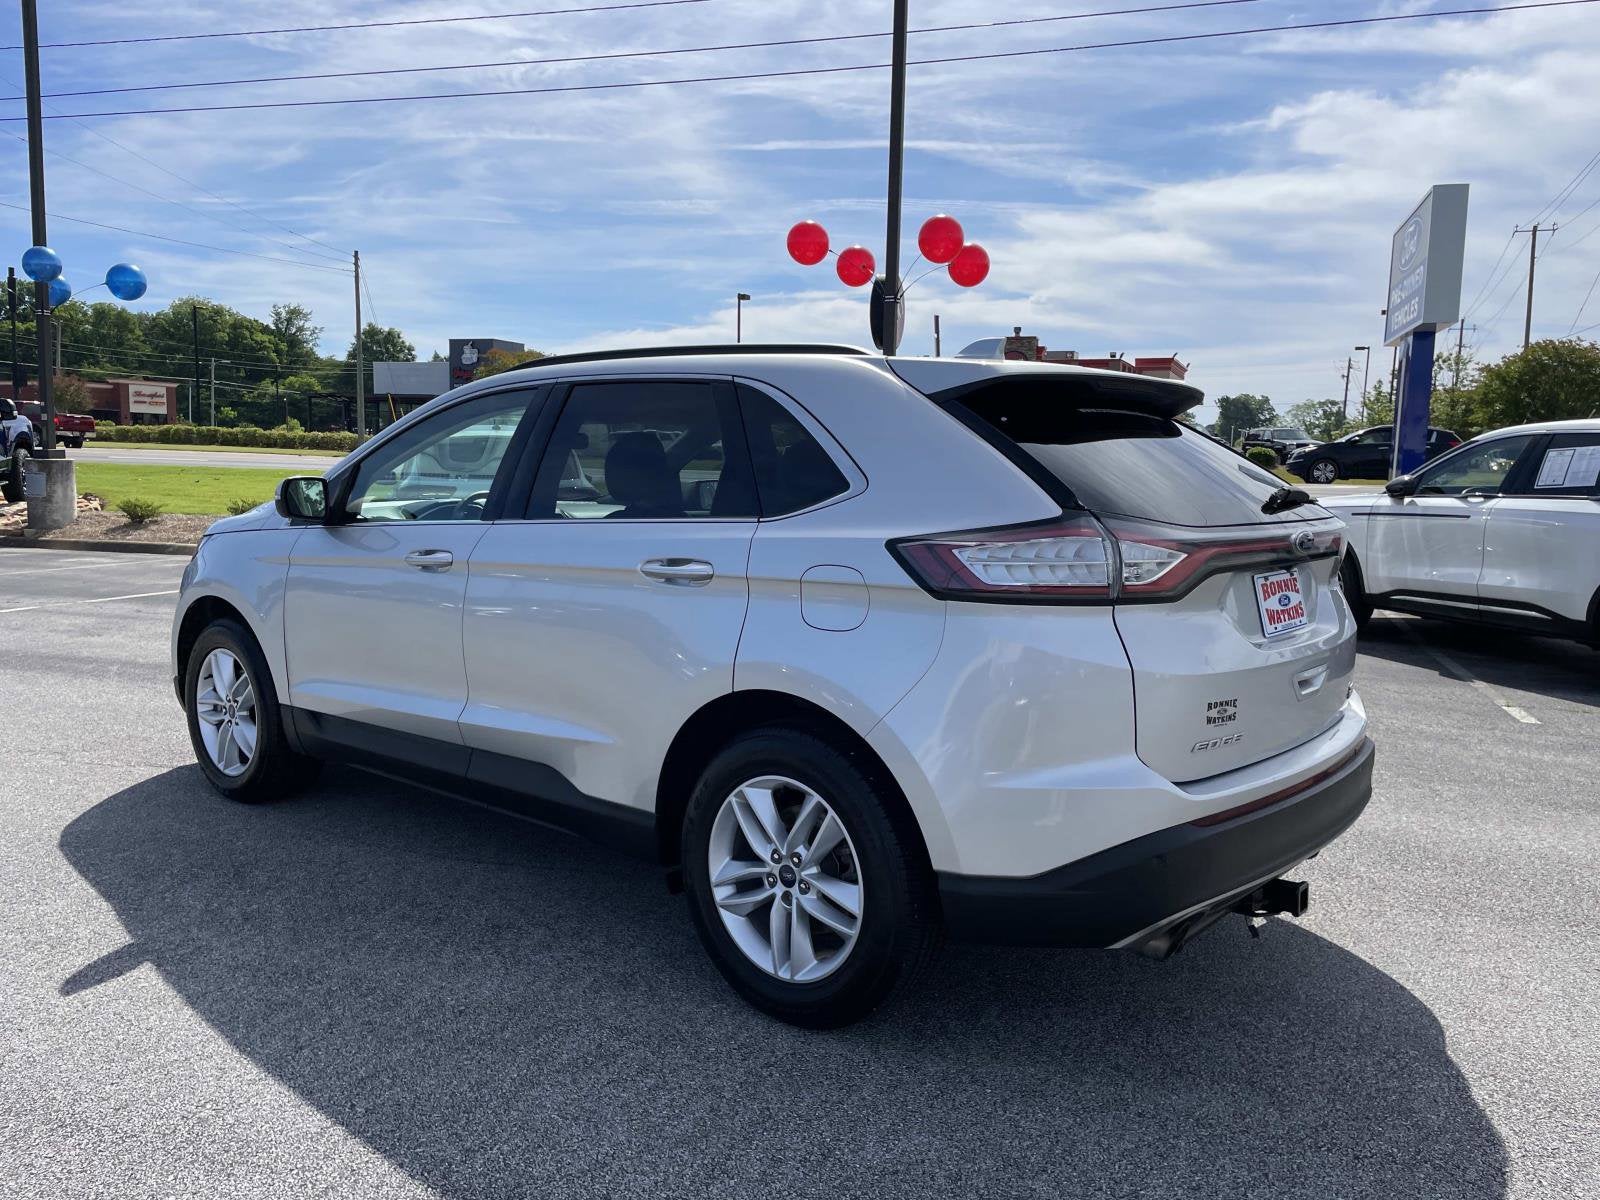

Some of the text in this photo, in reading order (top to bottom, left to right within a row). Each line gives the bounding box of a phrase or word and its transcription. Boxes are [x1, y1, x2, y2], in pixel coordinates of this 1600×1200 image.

[1390, 297, 1419, 333] VEHICLES
[1261, 577, 1300, 602] RONNIE
[1265, 600, 1304, 626] WATKINS
[1206, 711, 1237, 725] WATKINS
[1207, 699, 1238, 712] RONNIE
